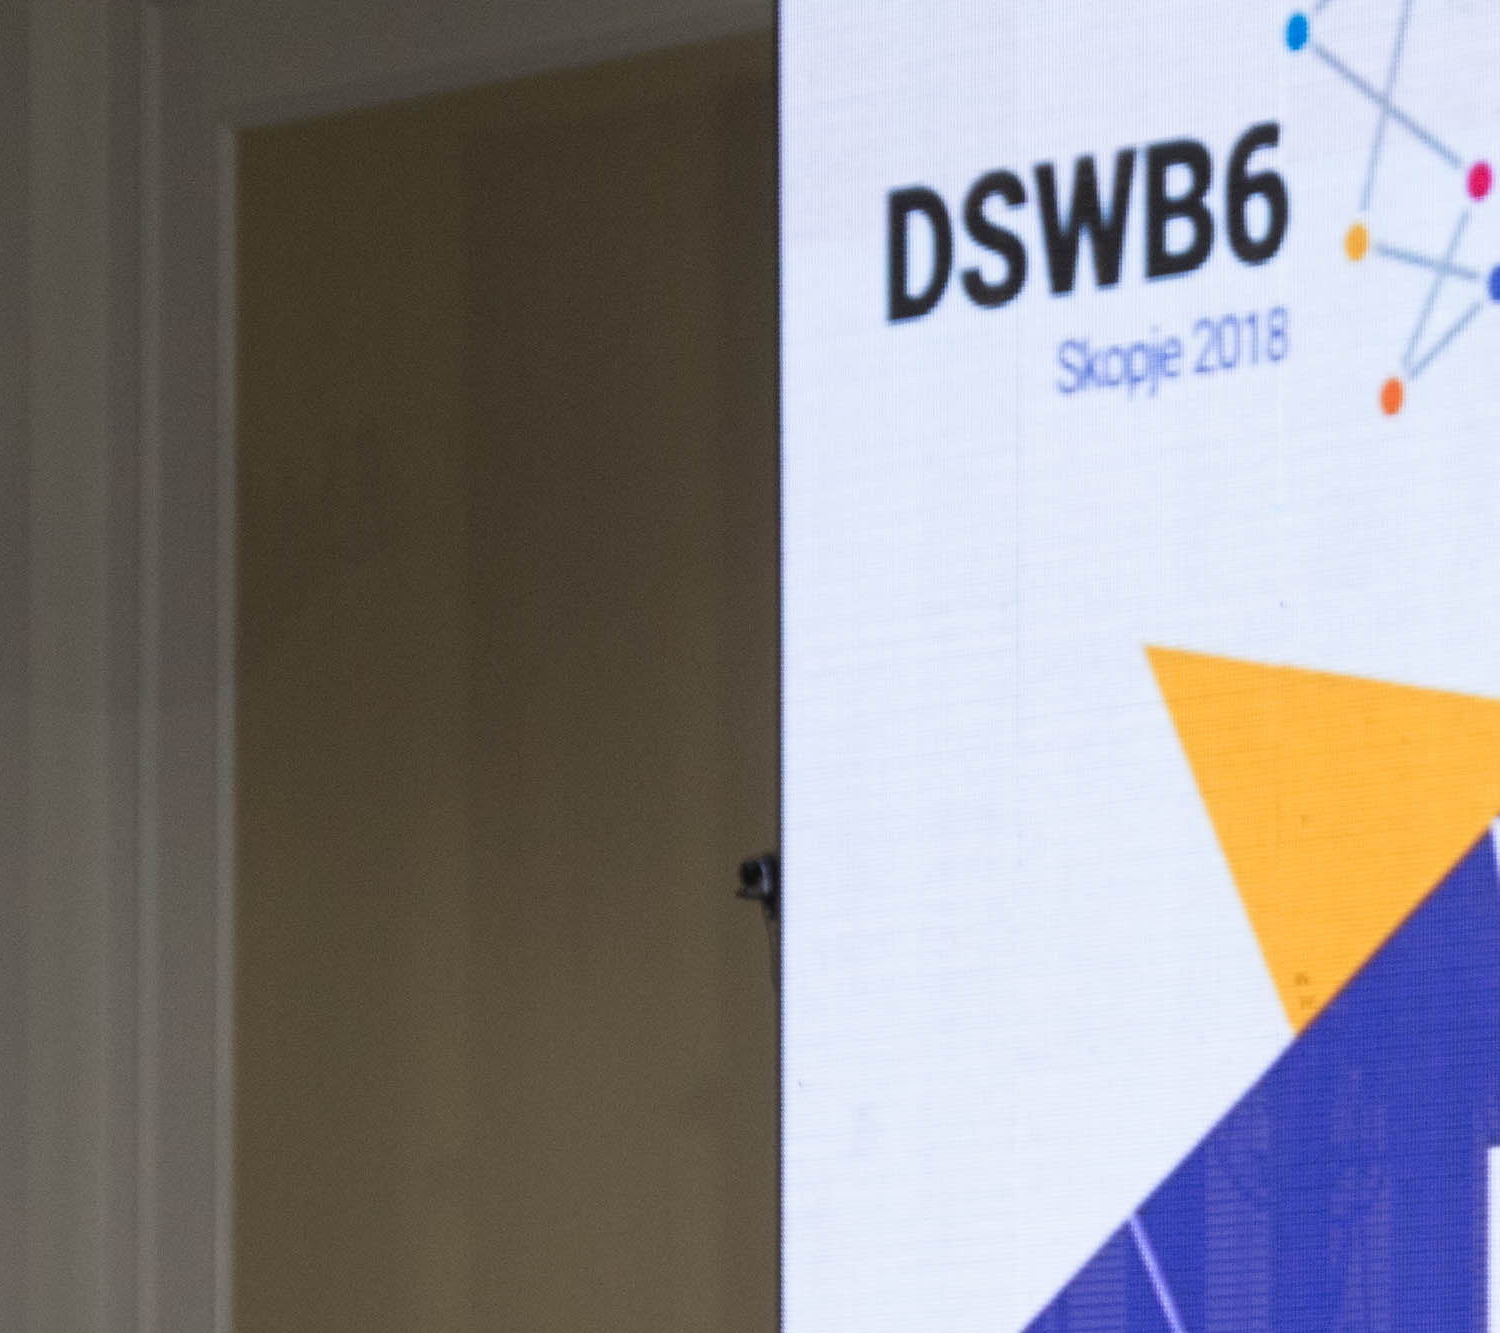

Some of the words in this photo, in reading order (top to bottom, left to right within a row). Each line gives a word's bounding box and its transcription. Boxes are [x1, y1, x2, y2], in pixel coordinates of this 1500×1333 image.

[886, 121, 1289, 325] DSWB6
[1057, 325, 1181, 397] Skopje
[1193, 305, 1288, 374] 2018
